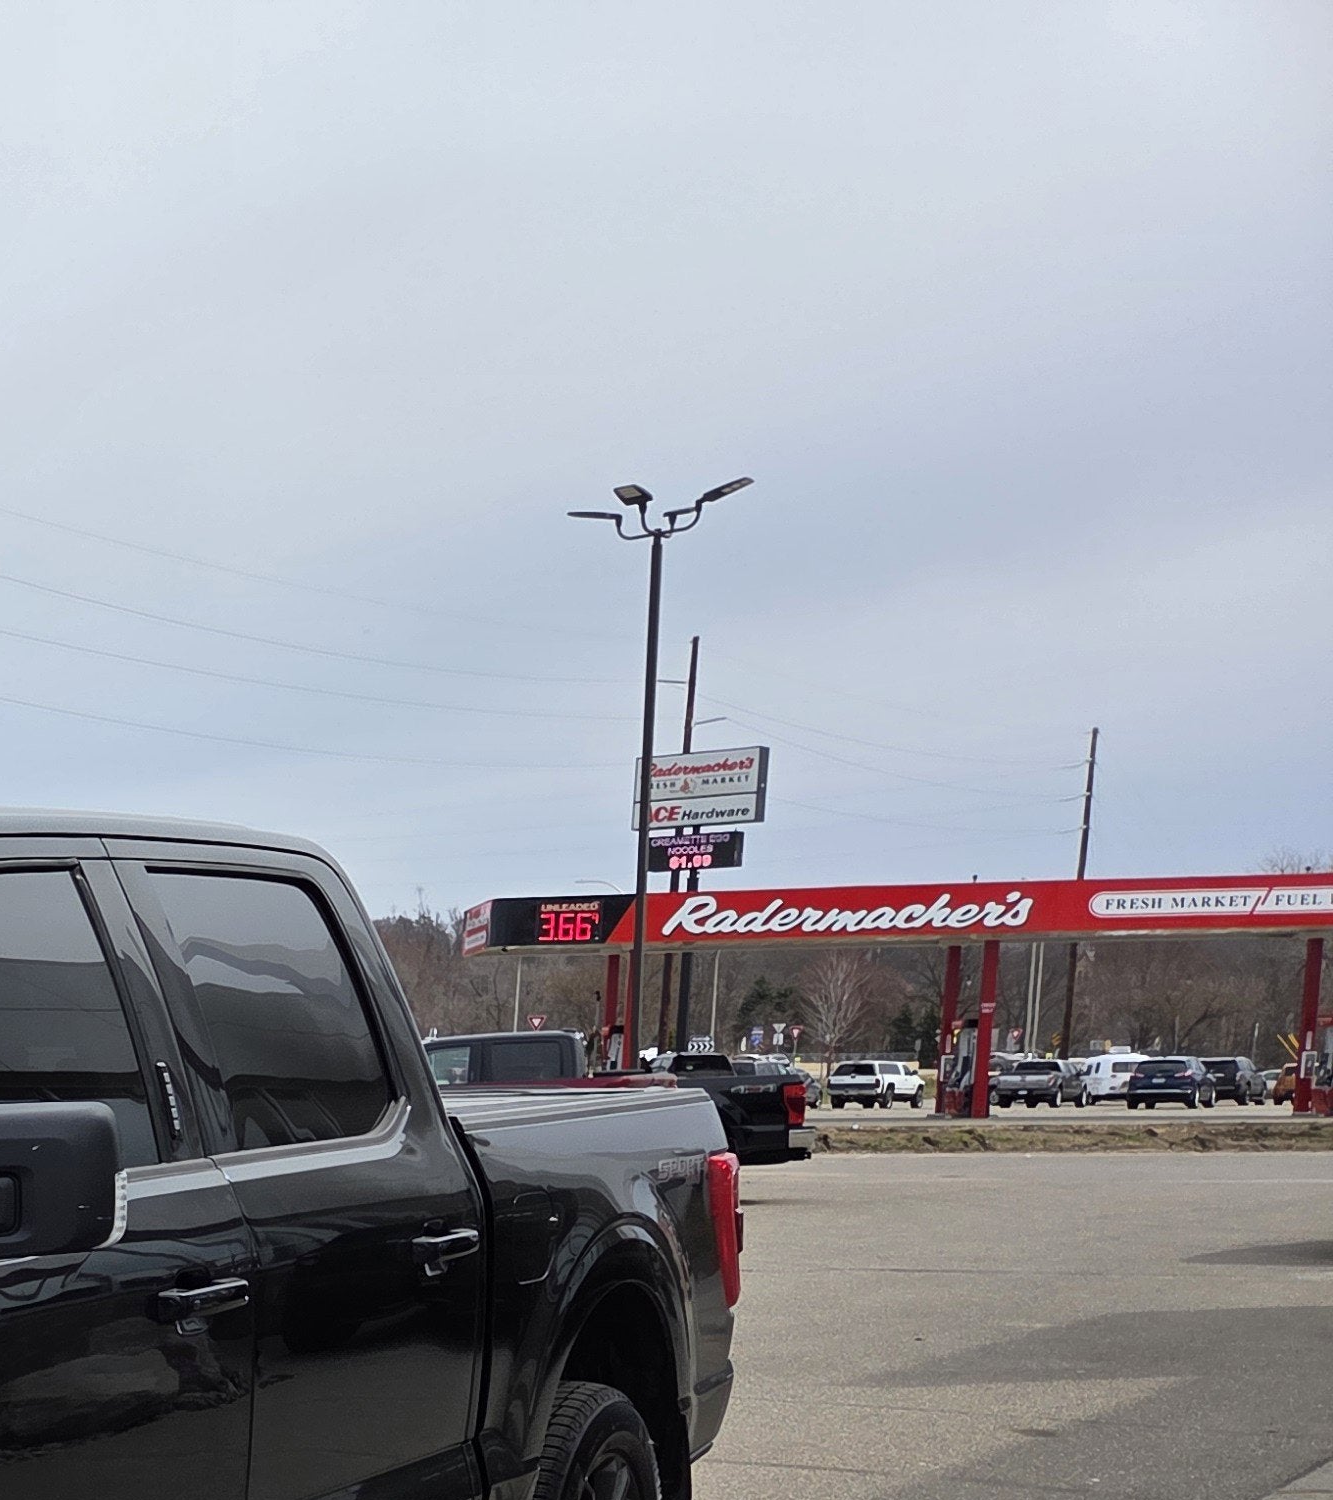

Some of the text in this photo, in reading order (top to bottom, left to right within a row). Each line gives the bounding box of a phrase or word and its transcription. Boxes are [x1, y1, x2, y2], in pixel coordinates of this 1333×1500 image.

[701, 774, 750, 786] MARKET
[648, 804, 750, 823] CE Hardware
[668, 844, 713, 857] NOODLES
[540, 901, 600, 912] UNLEADED
[1105, 897, 1162, 910] FRESH
[1171, 895, 1252, 909] MARKET
[1275, 893, 1323, 906] FUEL
[662, 890, 1034, 937] Radermacher's
[656, 1155, 705, 1183] SPORT
